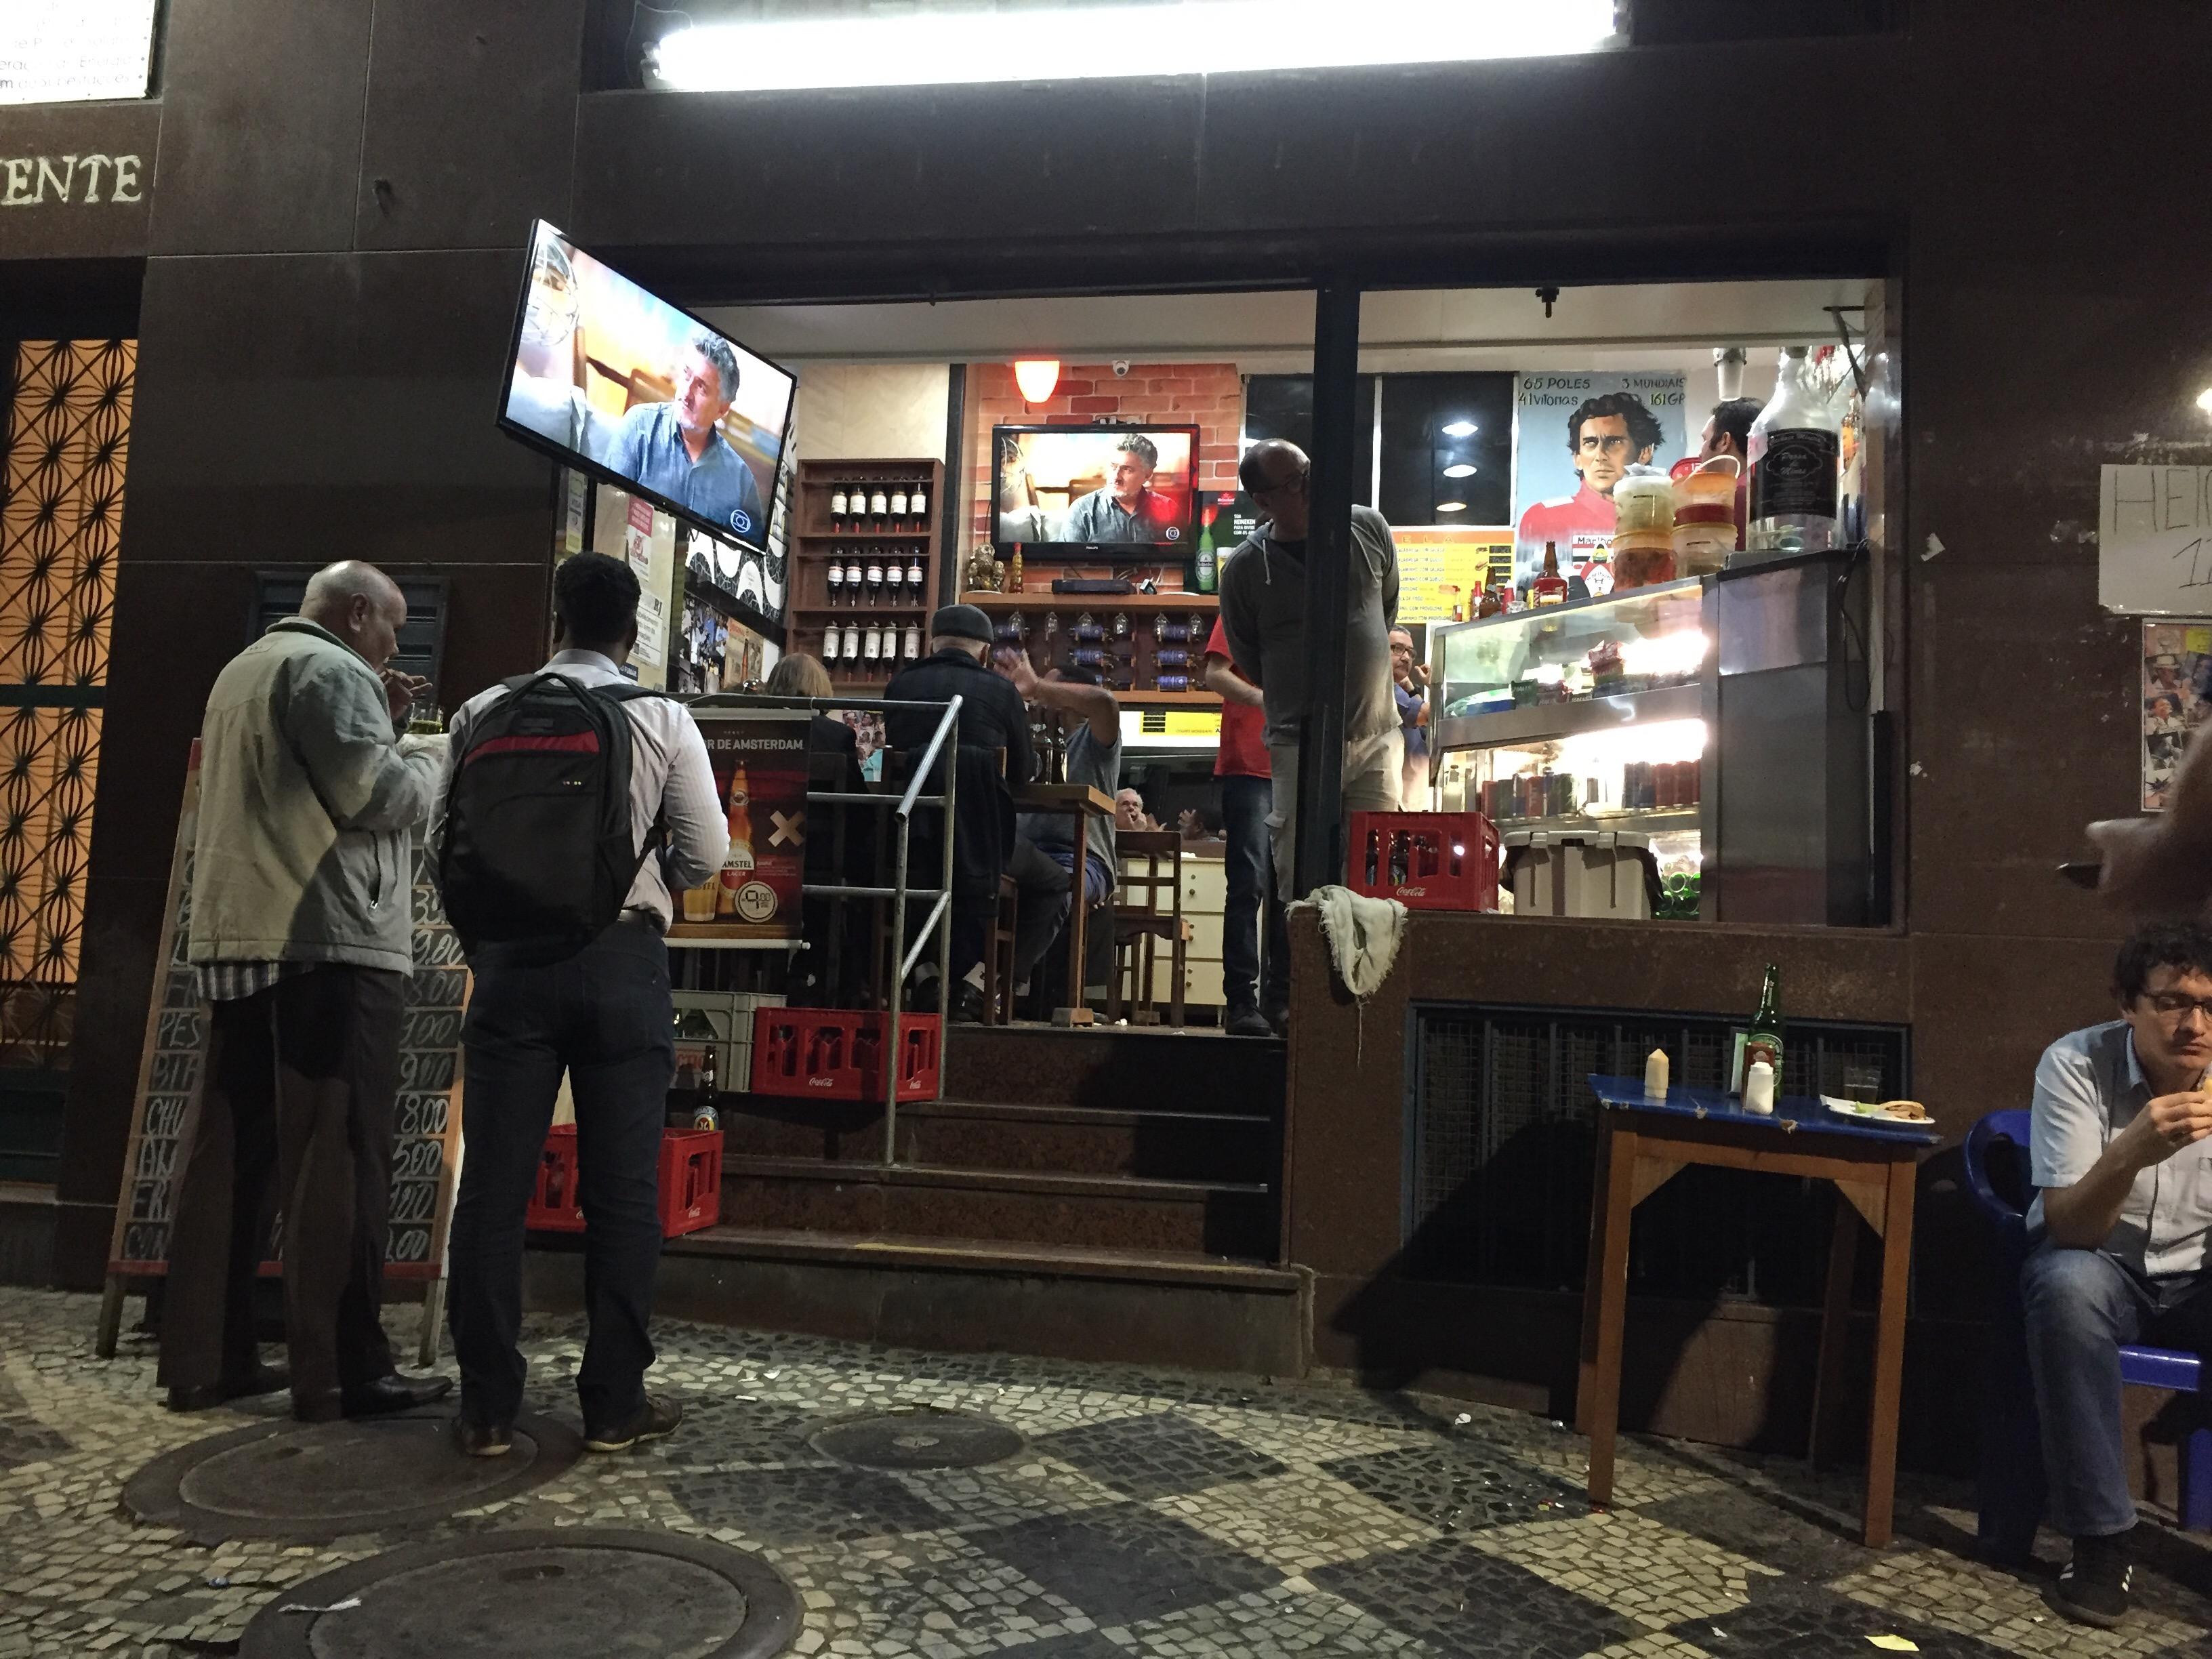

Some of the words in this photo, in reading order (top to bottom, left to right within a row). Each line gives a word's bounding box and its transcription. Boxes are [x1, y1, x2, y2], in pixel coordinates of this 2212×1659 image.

[0, 155, 142, 205] ENTE
[1523, 377, 1544, 390] 65
[1547, 377, 1591, 390] POLES
[1622, 378, 1630, 390] 3
[1633, 377, 1687, 390] MUNDIAIS
[717, 739, 731, 750] DE
[733, 739, 804, 750] AMSTERDAM
[722, 860, 752, 868] AMSTEL
